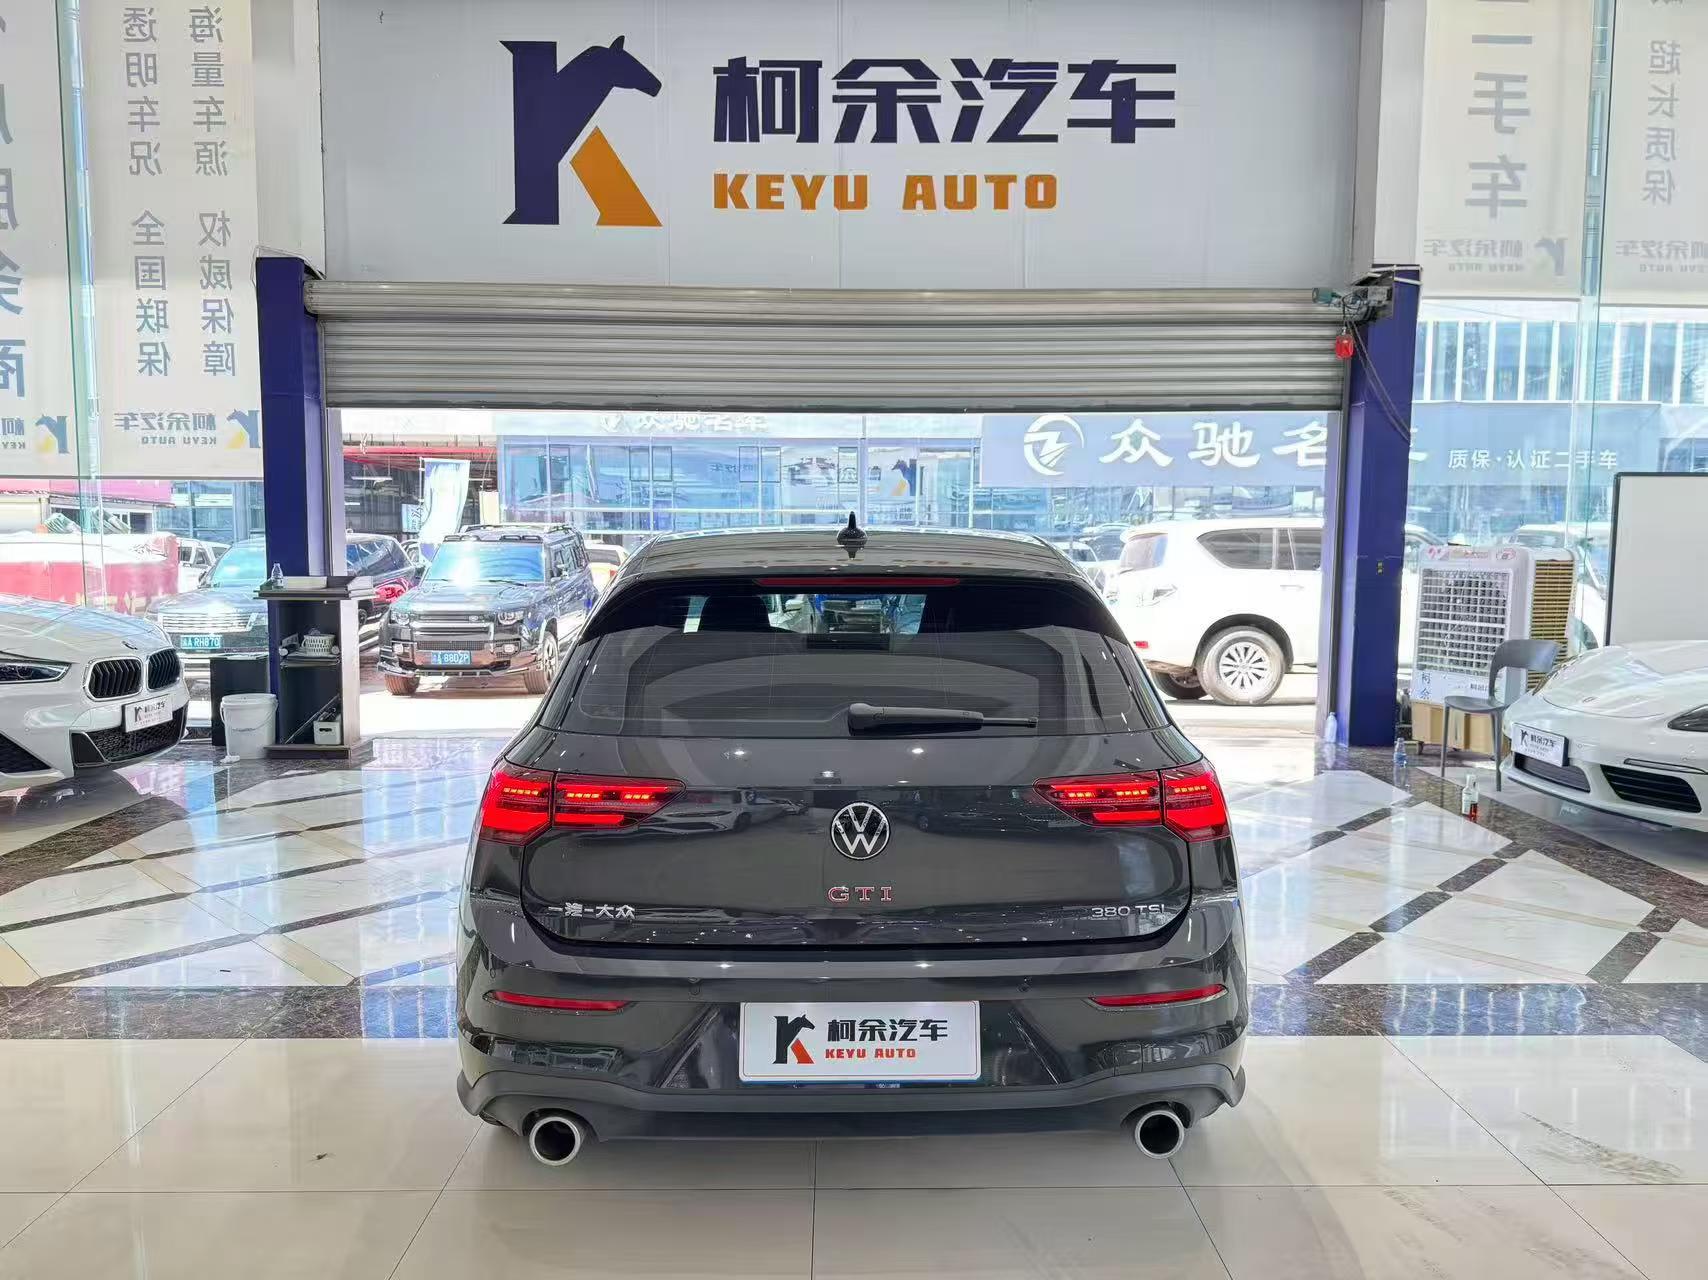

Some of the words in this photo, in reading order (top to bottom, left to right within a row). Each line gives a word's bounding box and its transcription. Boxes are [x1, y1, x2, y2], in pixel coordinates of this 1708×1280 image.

[712, 56, 1177, 144] 柯余汽车
[713, 173, 868, 210] KEYU
[902, 174, 1058, 210] AUTO
[1099, 418, 1427, 468] 众驰名
[828, 885, 895, 904] GTI
[1092, 906, 1130, 918] 380
[1135, 904, 1165, 915] TSI
[827, 1019, 948, 1042] 柯余汽车
[825, 1048, 866, 1059] KEYU
[874, 1048, 917, 1059] AUTO
